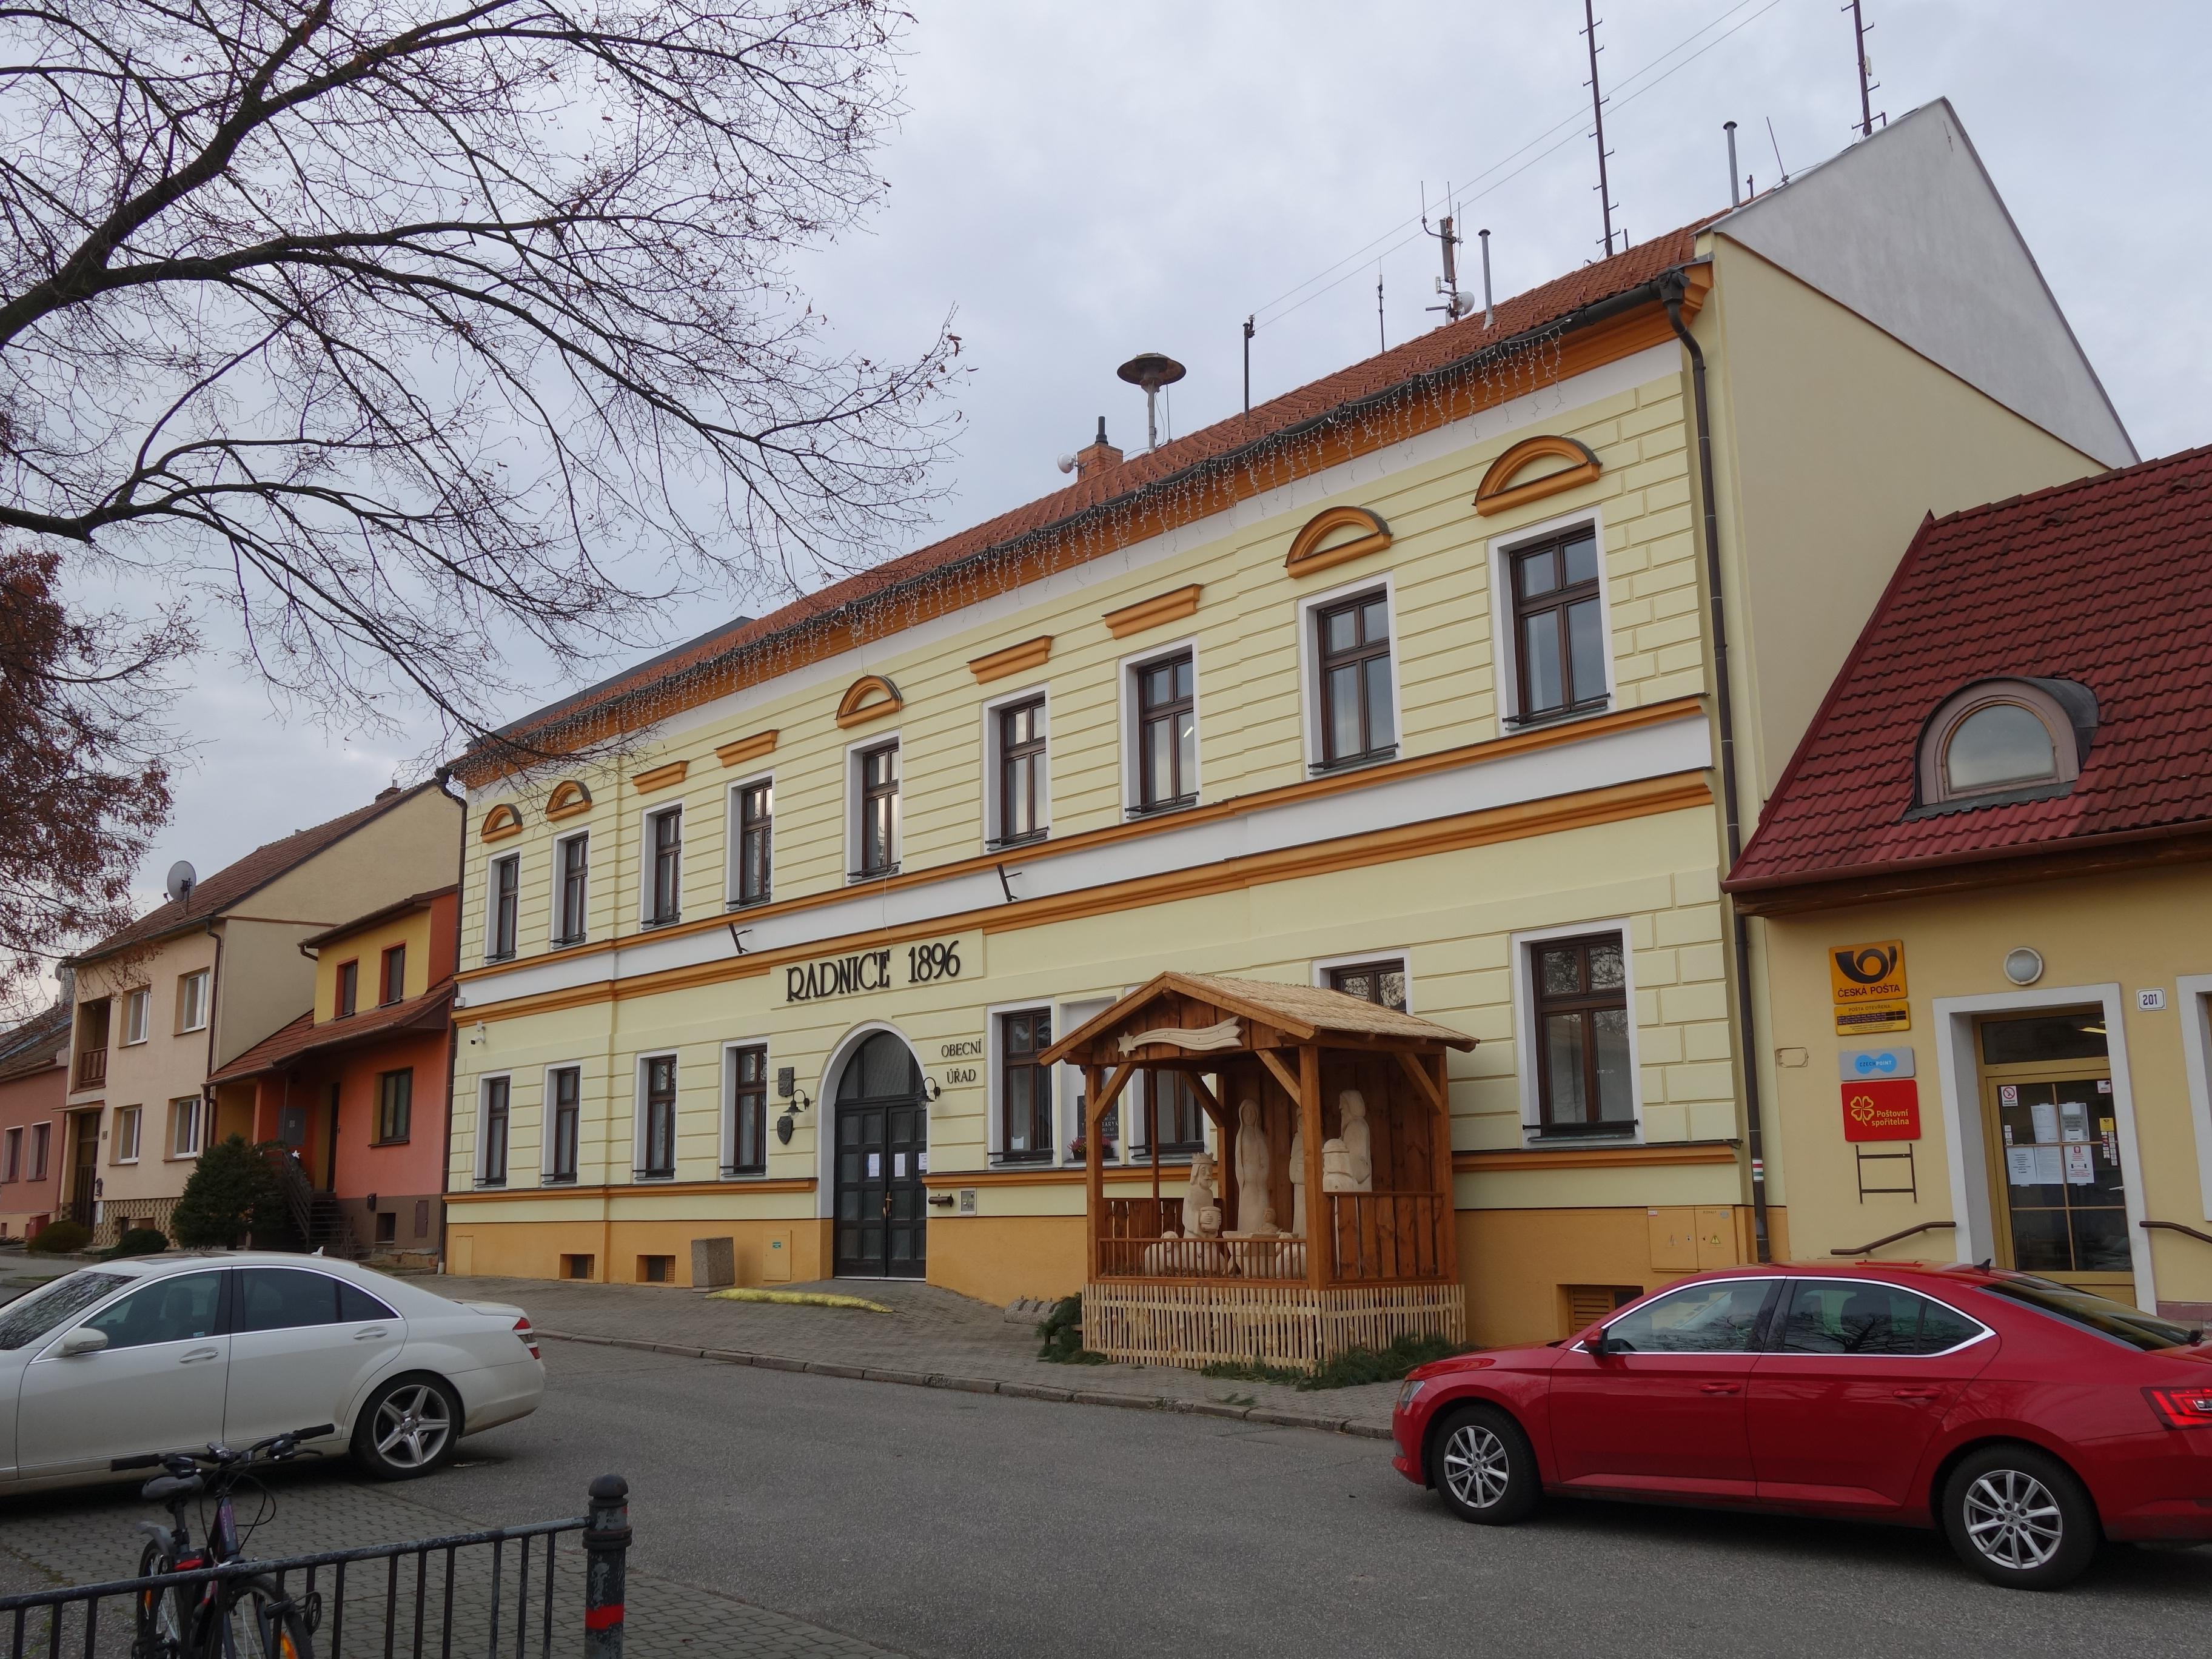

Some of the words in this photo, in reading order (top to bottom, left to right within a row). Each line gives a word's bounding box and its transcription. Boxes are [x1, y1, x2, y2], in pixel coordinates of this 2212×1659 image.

[786, 949, 890, 1002] RADNICE
[908, 940, 960, 983] 1896
[1838, 985, 1867, 997] ČESKÁ
[1870, 984, 1900, 994] POŠTA
[2142, 993, 2157, 1006] 201
[941, 1038, 982, 1057] OBECNÍ
[947, 1068, 976, 1084] ÚŘAD
[1877, 1108, 1908, 1118] Poštovní
[1871, 1117, 1909, 1128] spořitelna
